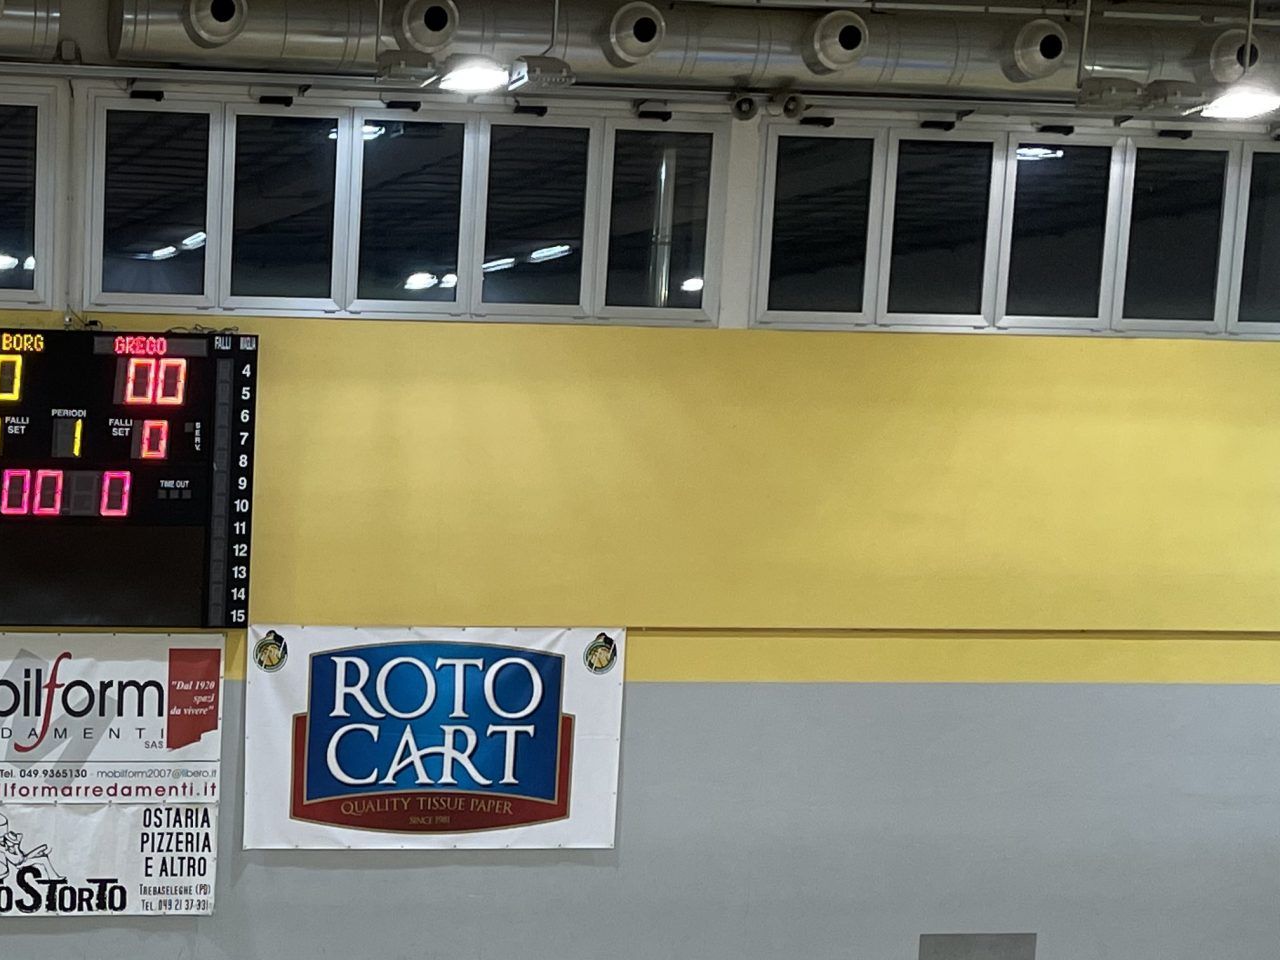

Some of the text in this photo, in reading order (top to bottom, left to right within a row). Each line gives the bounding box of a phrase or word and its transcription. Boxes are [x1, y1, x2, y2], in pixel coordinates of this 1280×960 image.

[2, 333, 45, 351] BORG
[114, 336, 167, 355] GREGO
[242, 364, 251, 378] 4
[124, 357, 187, 405] 00
[241, 387, 251, 400] 5
[51, 408, 87, 418] PERIODI
[240, 410, 250, 423] 6
[5, 416, 29, 425] FALLI
[109, 418, 133, 426] FALLI
[7, 425, 26, 434] SET
[112, 428, 131, 436] SET
[72, 419, 82, 457] 1
[141, 420, 168, 459] 0
[239, 432, 249, 445] 7
[239, 454, 248, 468] 8
[238, 477, 247, 490] 9
[234, 499, 249, 513] 10
[234, 522, 247, 535] 11
[233, 543, 248, 557] 12
[232, 565, 247, 579] 13
[231, 588, 246, 601] 14
[230, 609, 245, 623] 15
[195, 681, 215, 690] 1920
[328, 655, 544, 721] ROTO
[170, 706, 181, 715] da
[144, 740, 164, 749] SAS
[325, 722, 536, 787] CART
[0, 769, 16, 778] Tel.
[19, 769, 39, 778] 049
[42, 769, 88, 778] 9365130
[340, 797, 514, 816] QUALITY TISSUE PAPER
[142, 807, 211, 829] OSTARIA
[409, 816, 433, 825] SINCE
[140, 832, 212, 853] PIZZERIA
[145, 856, 207, 877] E ALTRO
